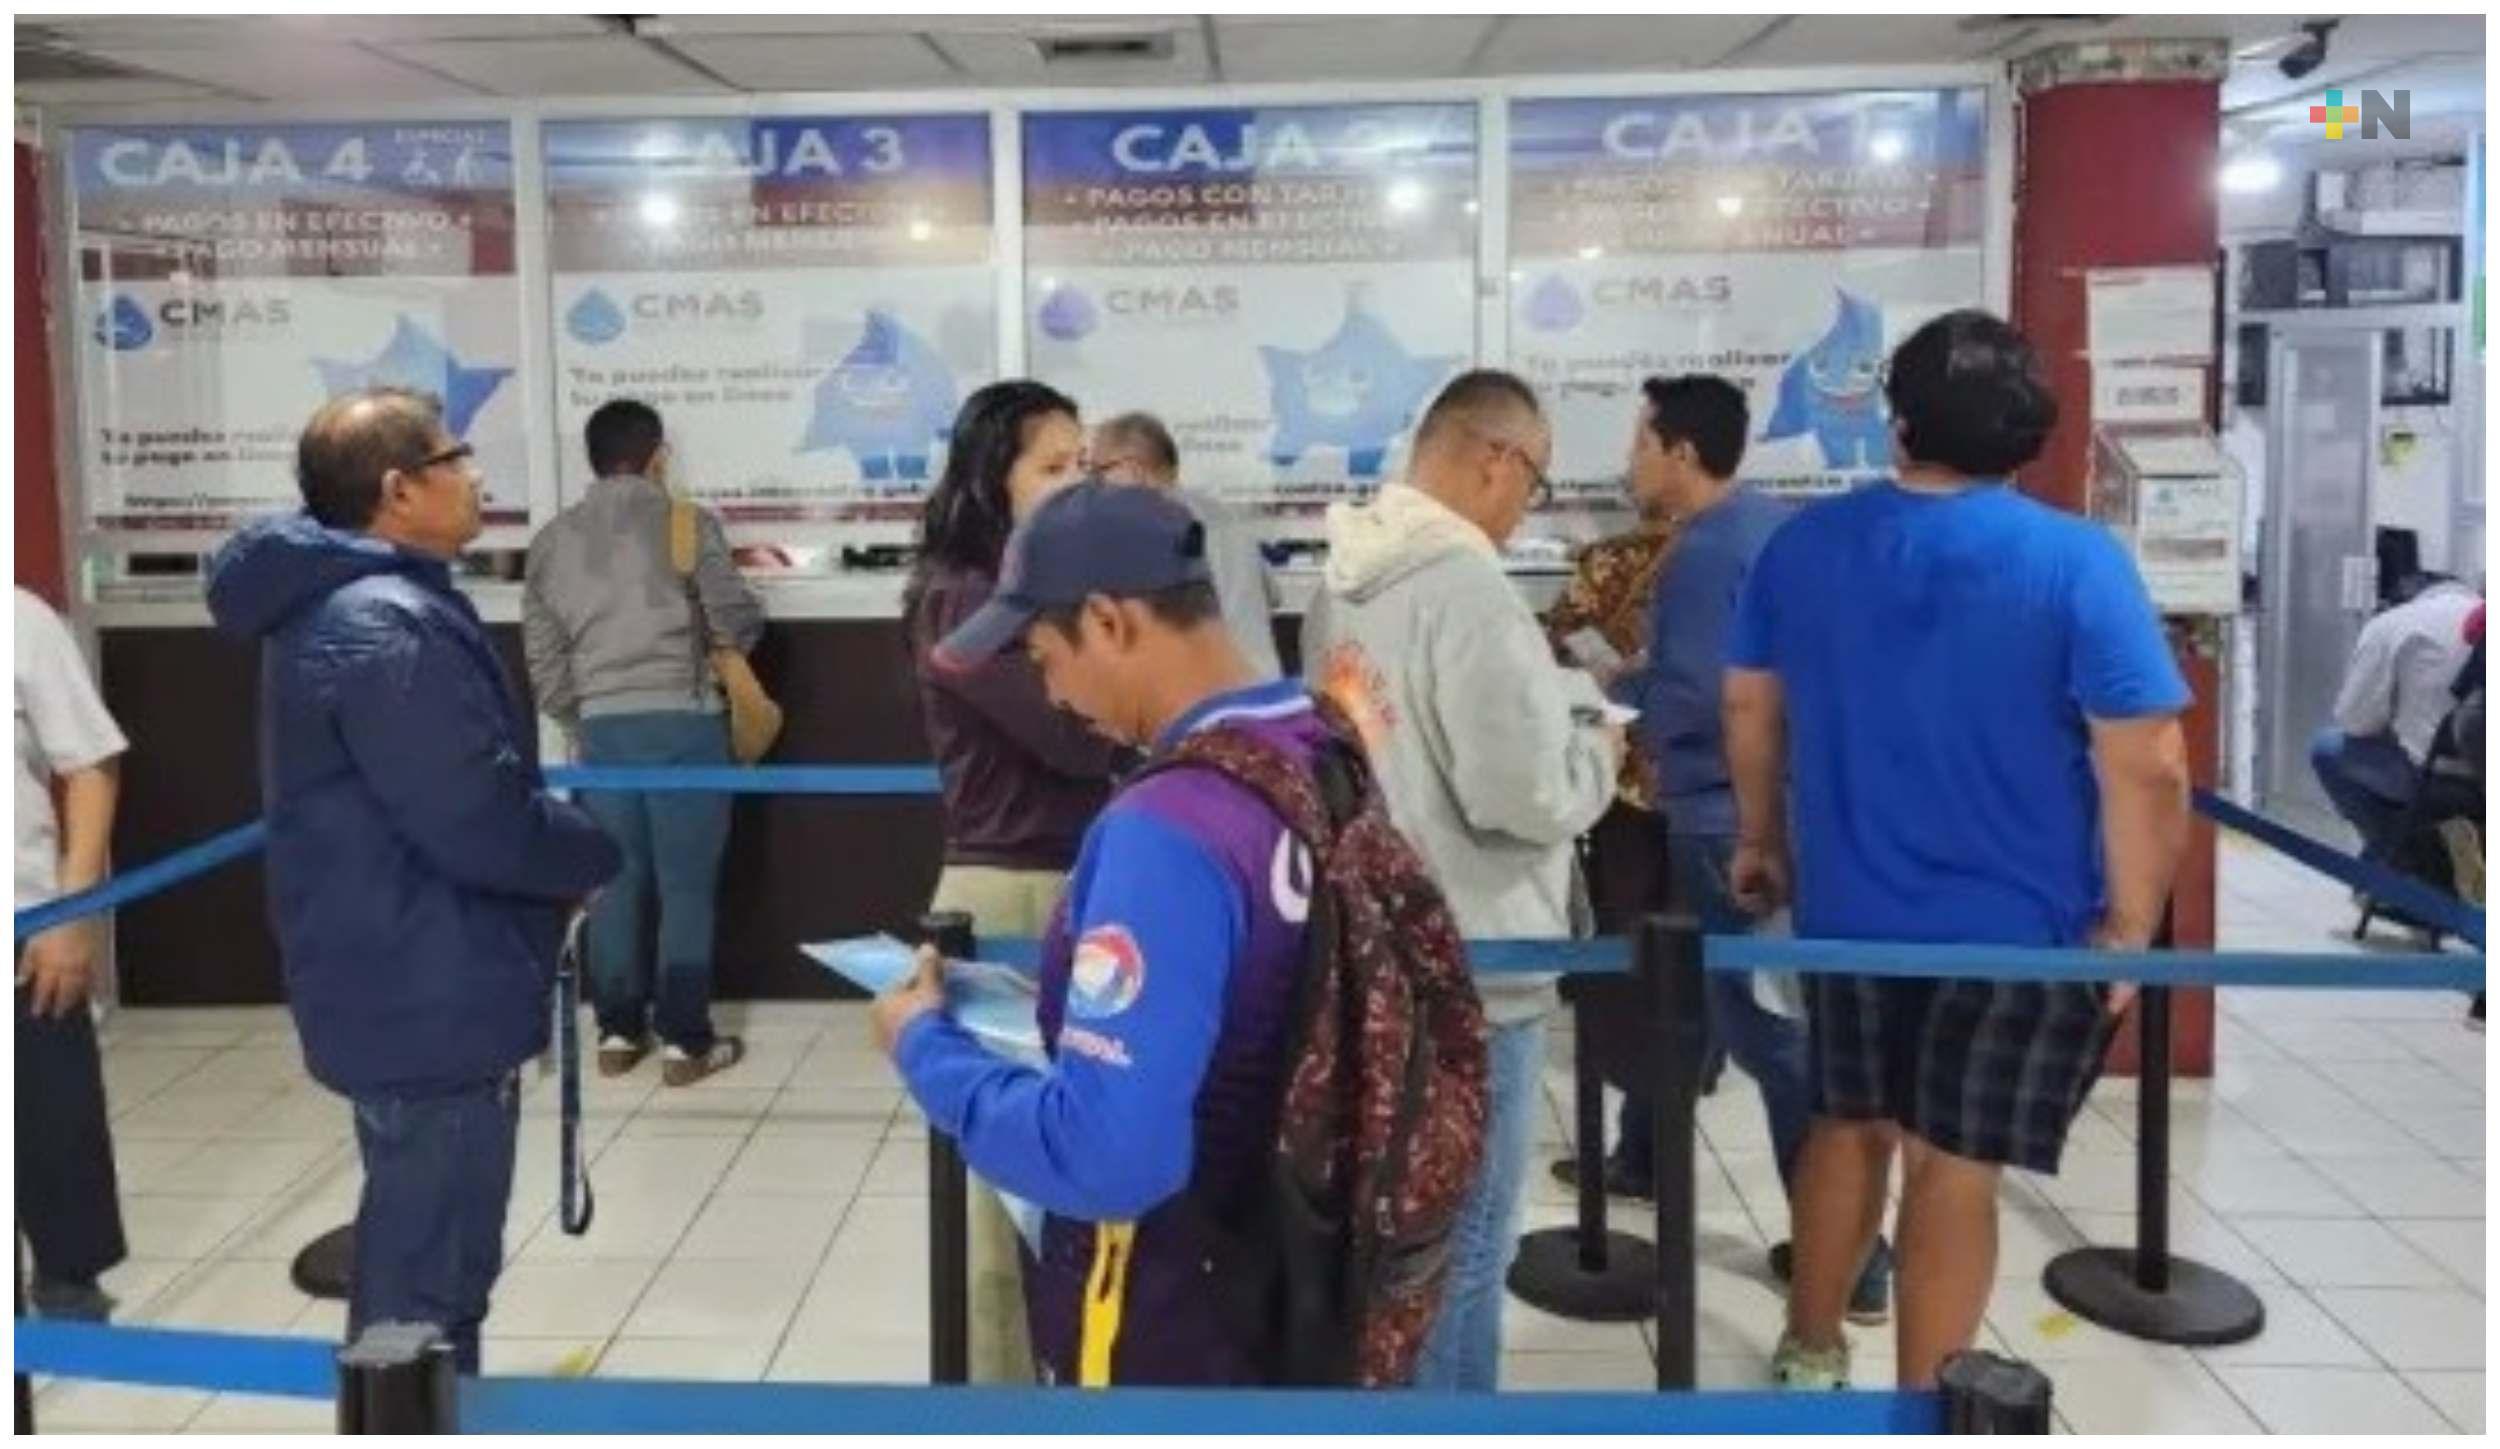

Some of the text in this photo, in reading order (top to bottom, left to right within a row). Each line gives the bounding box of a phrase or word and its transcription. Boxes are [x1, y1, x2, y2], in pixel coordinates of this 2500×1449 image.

[1112, 123, 1320, 173] CAJA
[1602, 109, 1820, 160] CAJA
[100, 136, 374, 187] CAJA 4
[700, 126, 904, 177] AJA 3
[1089, 187, 1193, 207] PAGOS
[1202, 185, 1278, 206] CON
[144, 211, 450, 232] PAGOS EN EFECTIVO
[1093, 214, 1198, 234] PAGOS
[1208, 212, 1250, 232] EN
[269, 239, 417, 258] MENSUAL
[1124, 237, 1376, 259] PAGO MENSUAL
[1106, 286, 1240, 315] CMAS
[1590, 275, 1733, 304] CMAS
[159, 299, 290, 327] CMAS
[632, 294, 766, 320] CMAS
